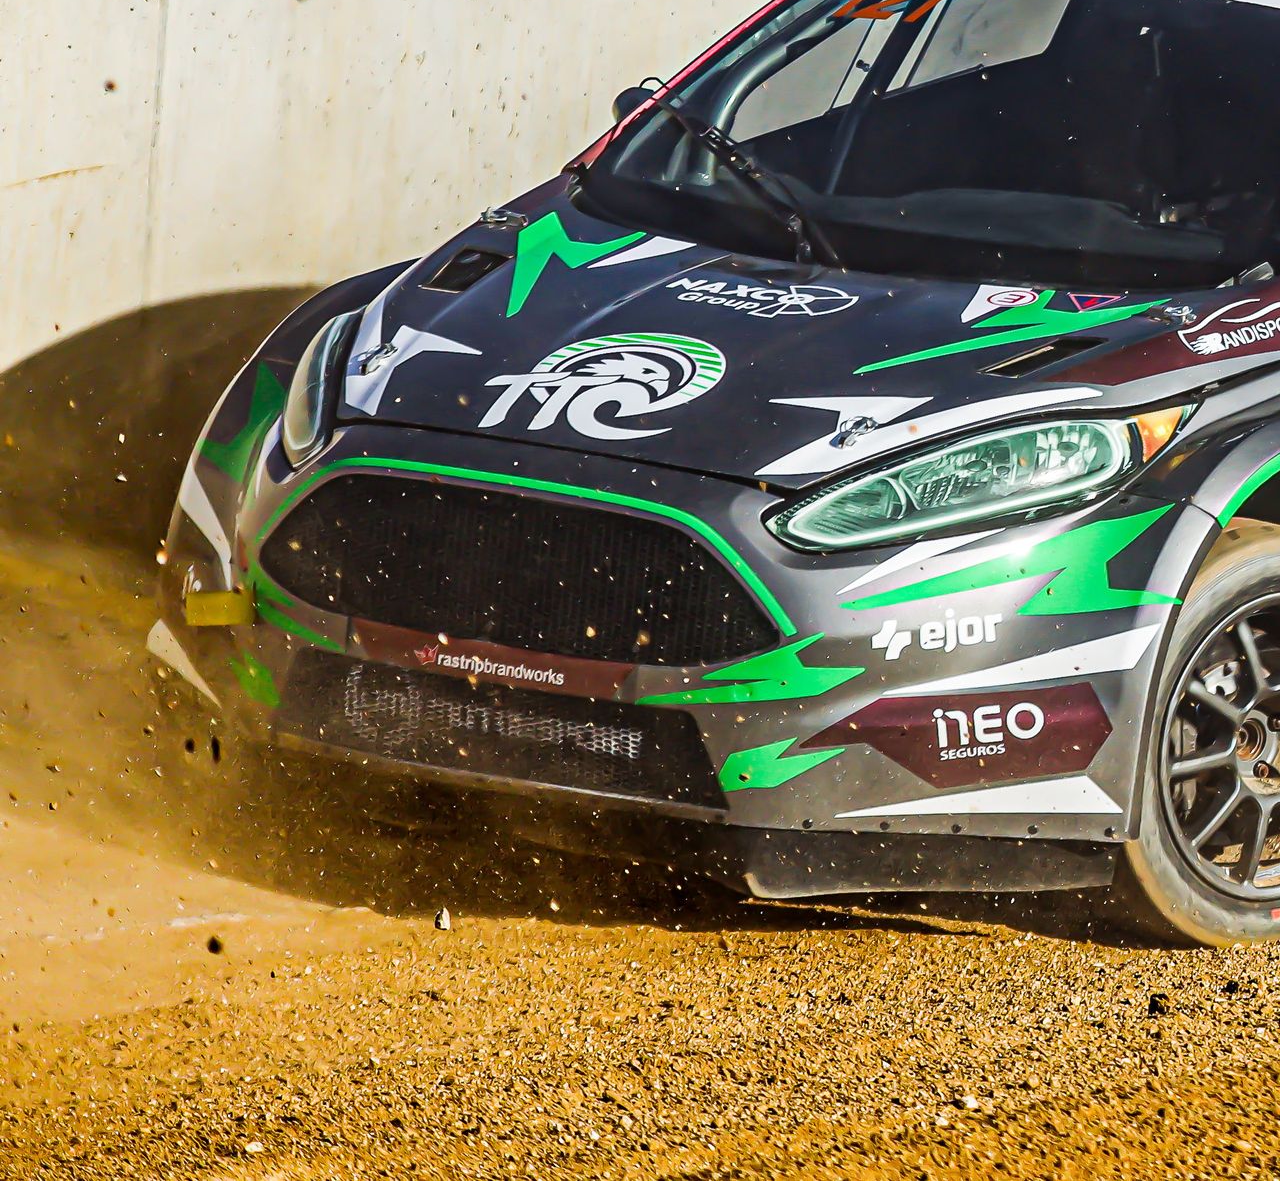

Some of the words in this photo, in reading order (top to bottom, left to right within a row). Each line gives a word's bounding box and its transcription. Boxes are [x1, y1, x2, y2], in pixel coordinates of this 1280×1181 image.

[677, 291, 761, 311] Group
[919, 608, 1004, 654] ejor
[436, 651, 566, 687] rastripbrandworks
[939, 743, 1007, 762] SEGUROS
